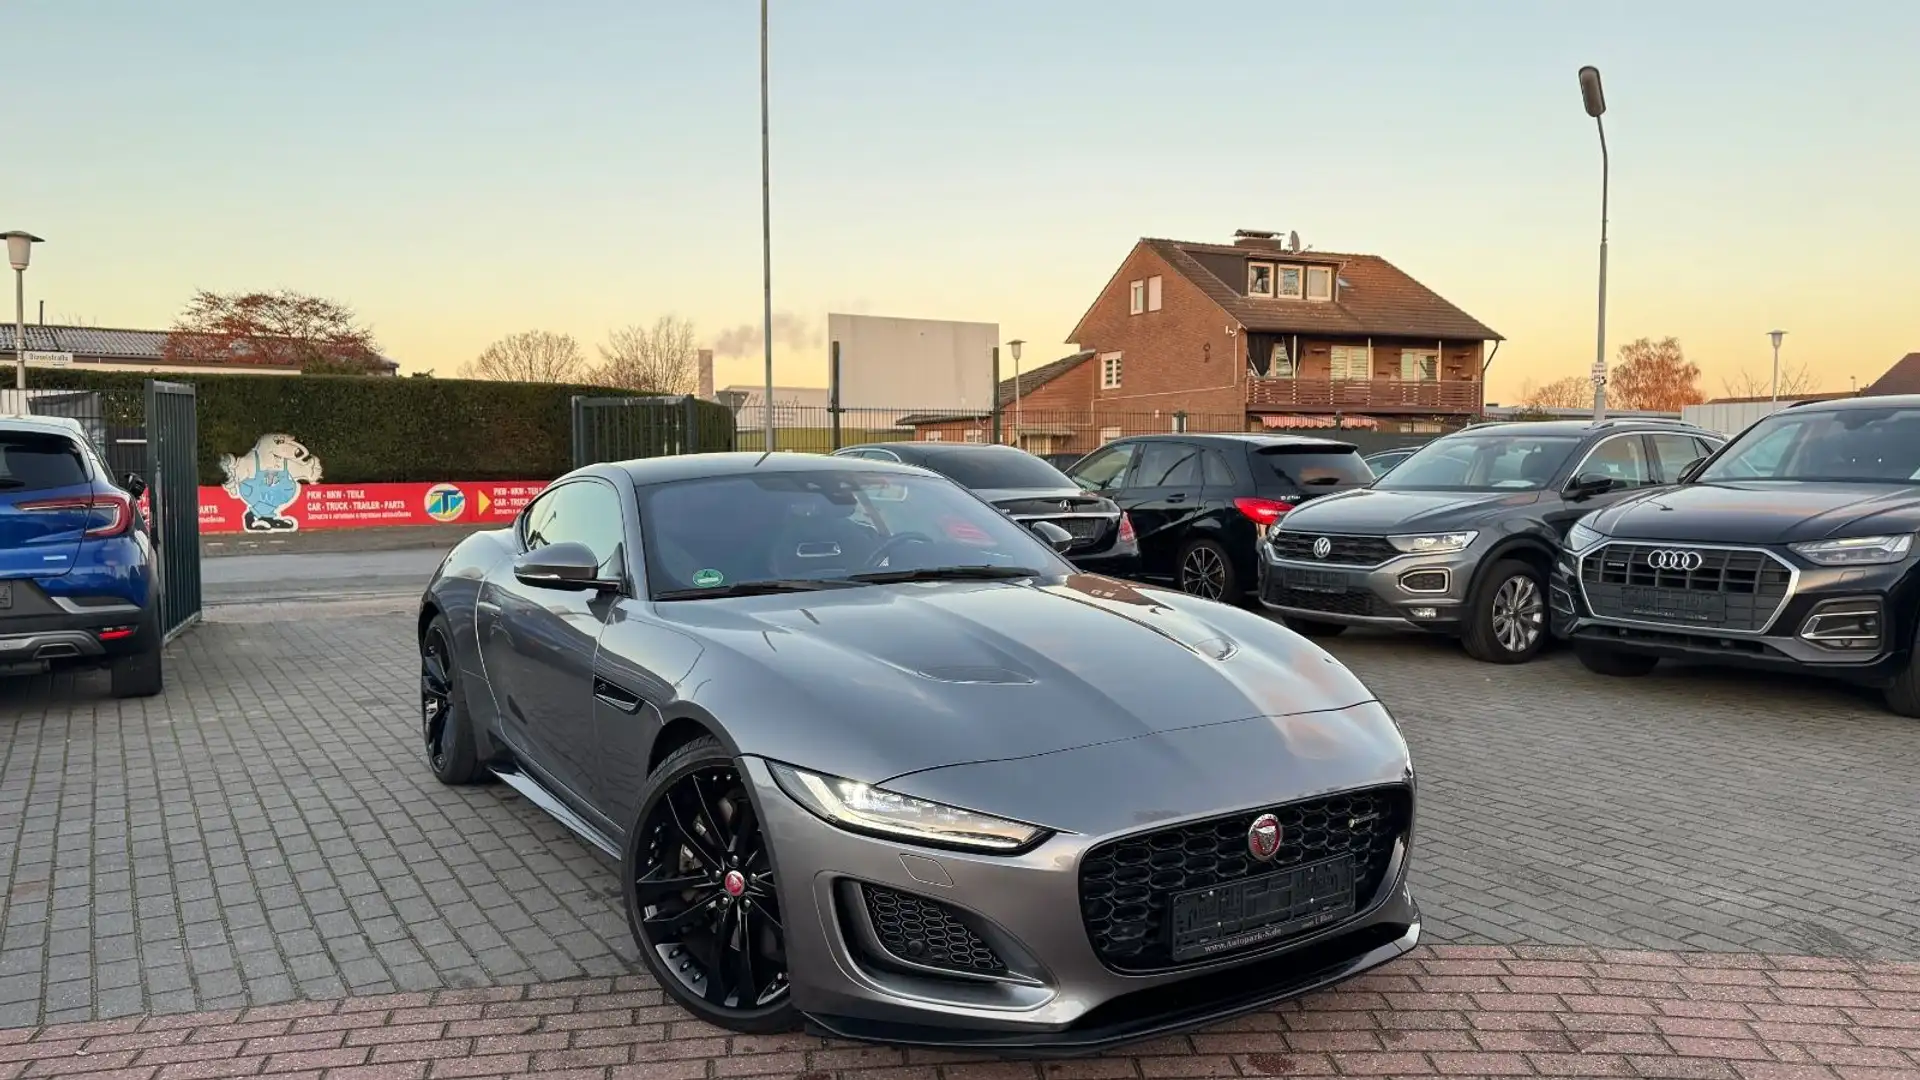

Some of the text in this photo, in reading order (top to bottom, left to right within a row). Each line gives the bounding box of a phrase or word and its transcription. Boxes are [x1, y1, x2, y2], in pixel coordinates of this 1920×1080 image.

[346, 490, 365, 498] TEILE
[198, 505, 218, 514] ARTS
[307, 500, 405, 511] CAR TRUCK TRAILER PARTS
